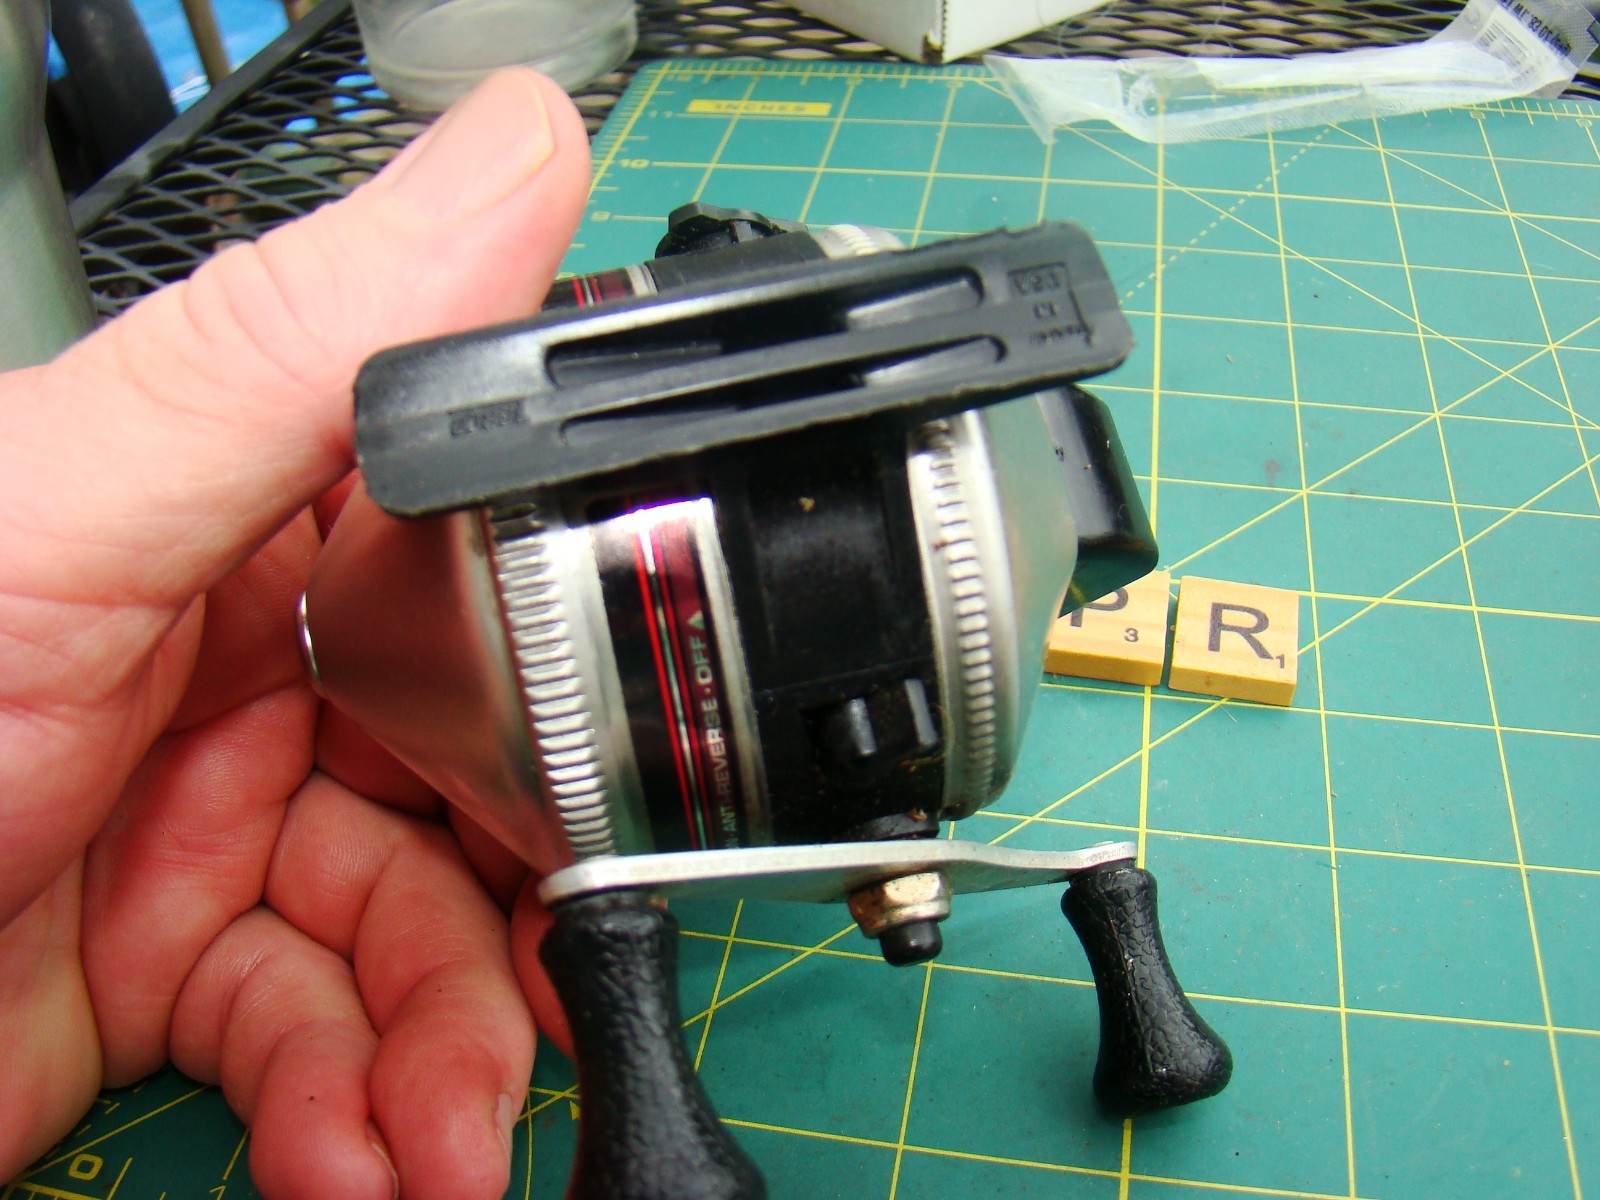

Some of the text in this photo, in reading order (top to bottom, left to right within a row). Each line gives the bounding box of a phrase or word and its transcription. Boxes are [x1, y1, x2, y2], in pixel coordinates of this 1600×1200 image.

[1069, 587, 1140, 643] P 3
[1207, 602, 1286, 669] R 1
[691, 636, 713, 685] OFF
